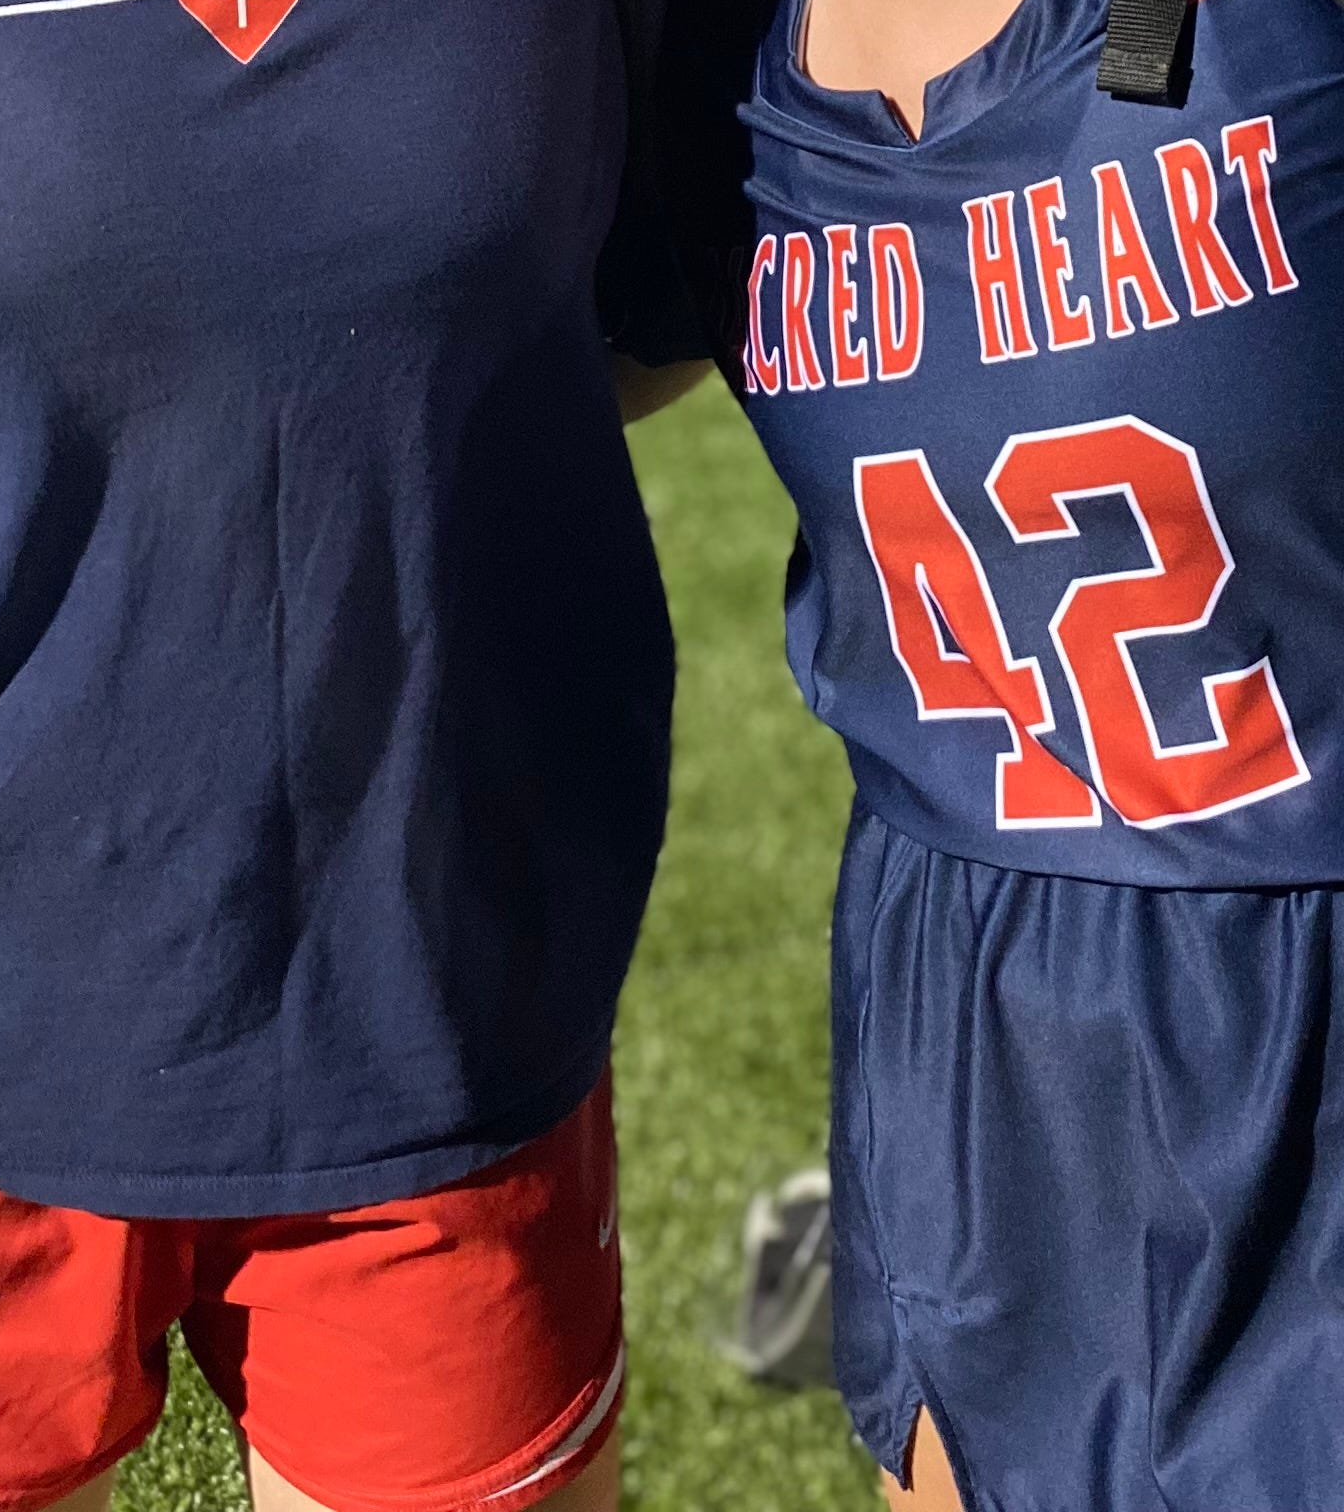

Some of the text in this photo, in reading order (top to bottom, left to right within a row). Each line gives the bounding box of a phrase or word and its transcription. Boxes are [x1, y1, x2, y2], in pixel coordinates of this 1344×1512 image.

[742, 114, 1299, 396] CRED HEART
[852, 414, 1311, 830] 42
